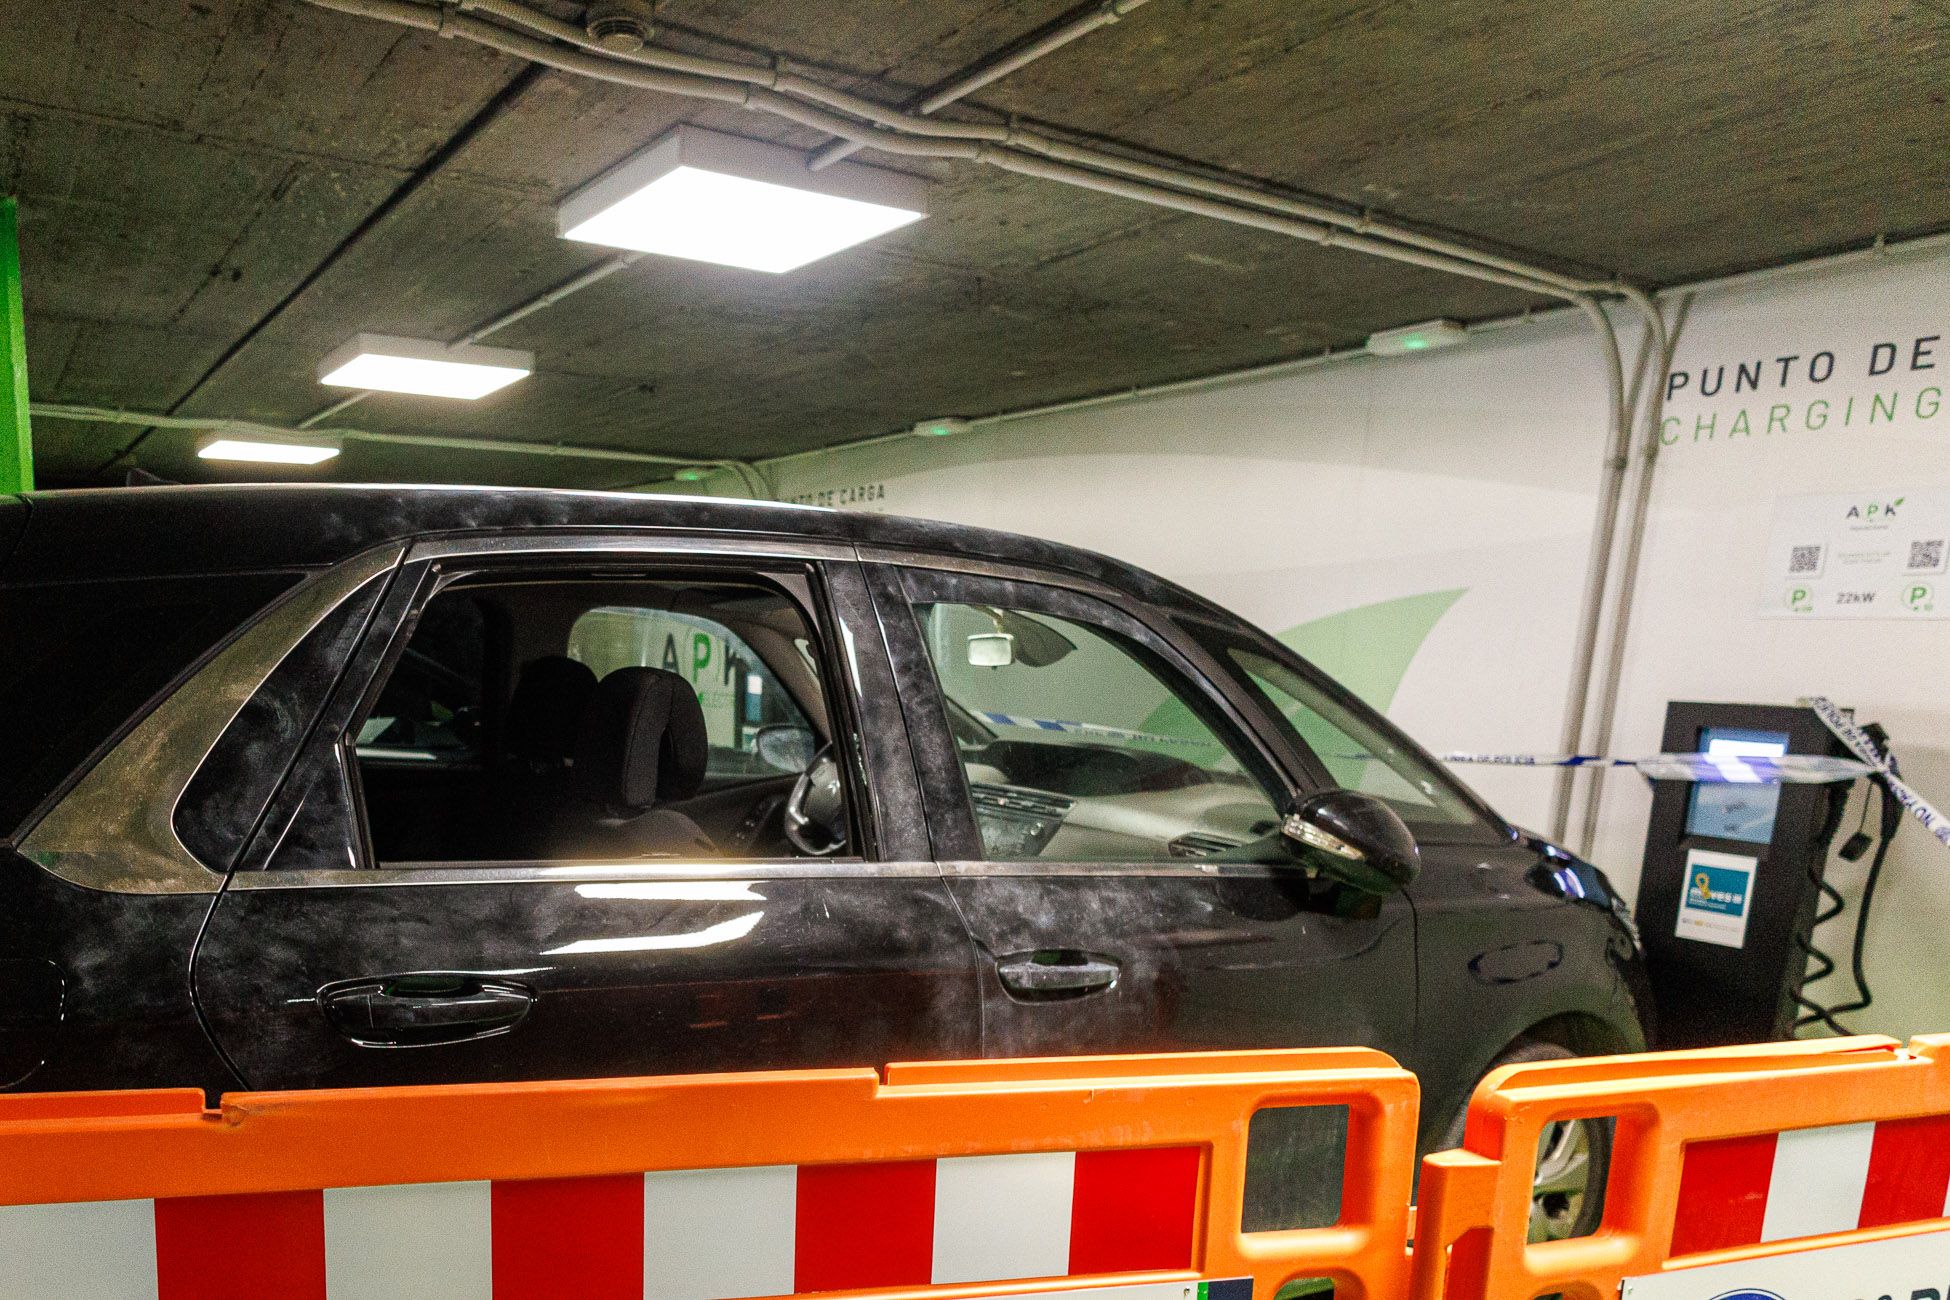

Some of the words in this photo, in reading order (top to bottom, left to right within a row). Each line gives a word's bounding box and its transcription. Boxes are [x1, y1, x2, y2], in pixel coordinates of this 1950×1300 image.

[1667, 351, 1835, 400] PUNTO
[1868, 335, 1941, 376] DE
[1659, 386, 1942, 446] CHARGING
[840, 484, 885, 505] CARGA
[1846, 503, 1896, 519] APK
[1836, 592, 1876, 605] 22kW
